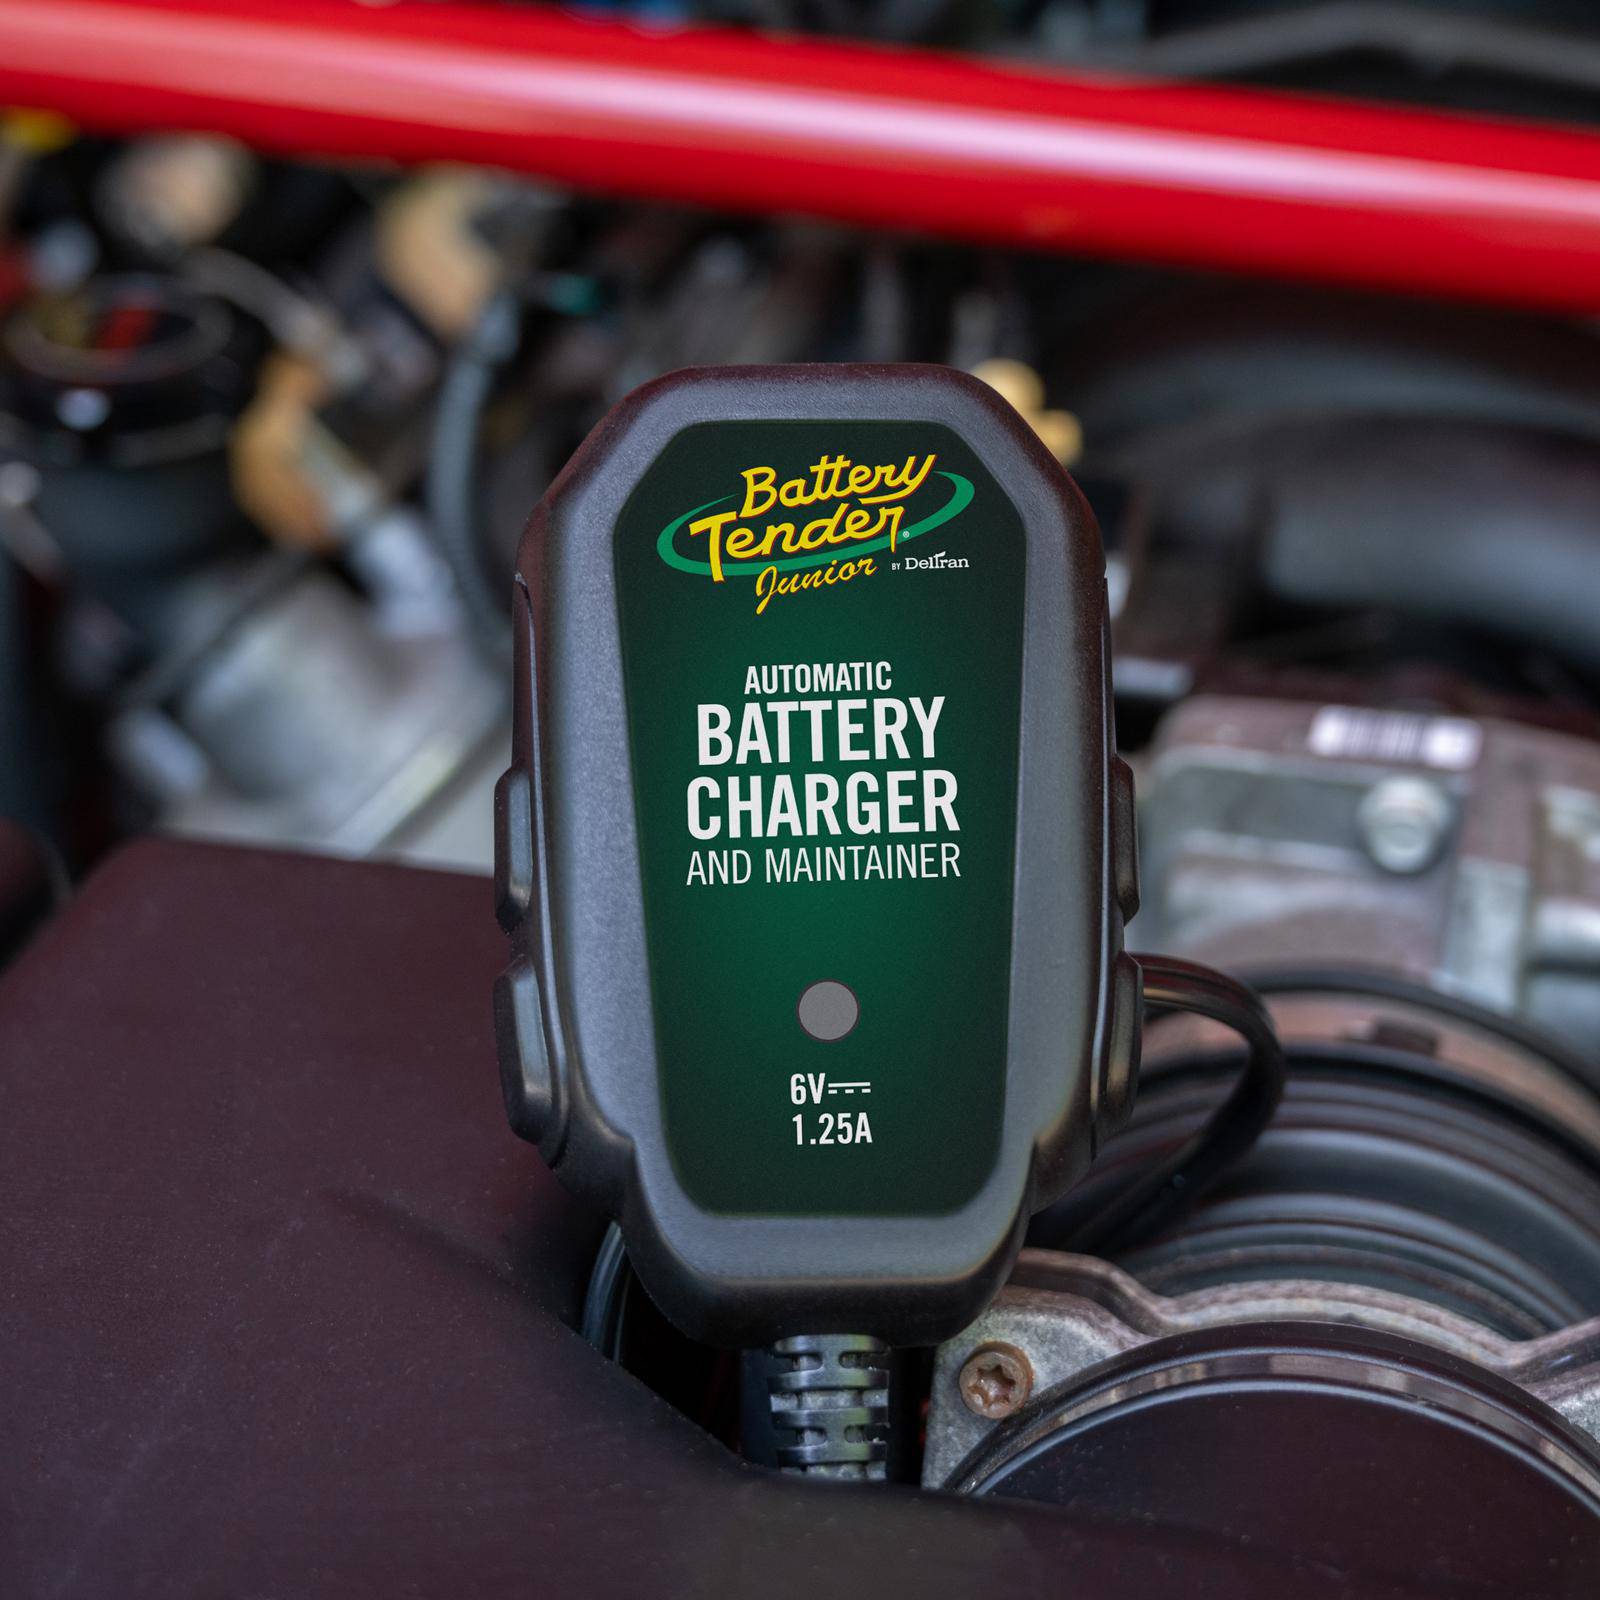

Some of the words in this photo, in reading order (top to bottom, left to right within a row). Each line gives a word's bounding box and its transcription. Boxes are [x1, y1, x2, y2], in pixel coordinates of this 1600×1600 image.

[740, 454, 937, 518] Battery
[689, 503, 905, 583] Tender
[891, 562, 901, 571] BY
[755, 557, 877, 615] Junior
[744, 661, 892, 695] AUTOMATIC
[697, 696, 946, 766] BATTERY
[686, 769, 961, 840] CHARGER
[686, 850, 752, 886] AND
[765, 842, 961, 883] MAINTAINER
[792, 1112, 873, 1146] 1.25A
